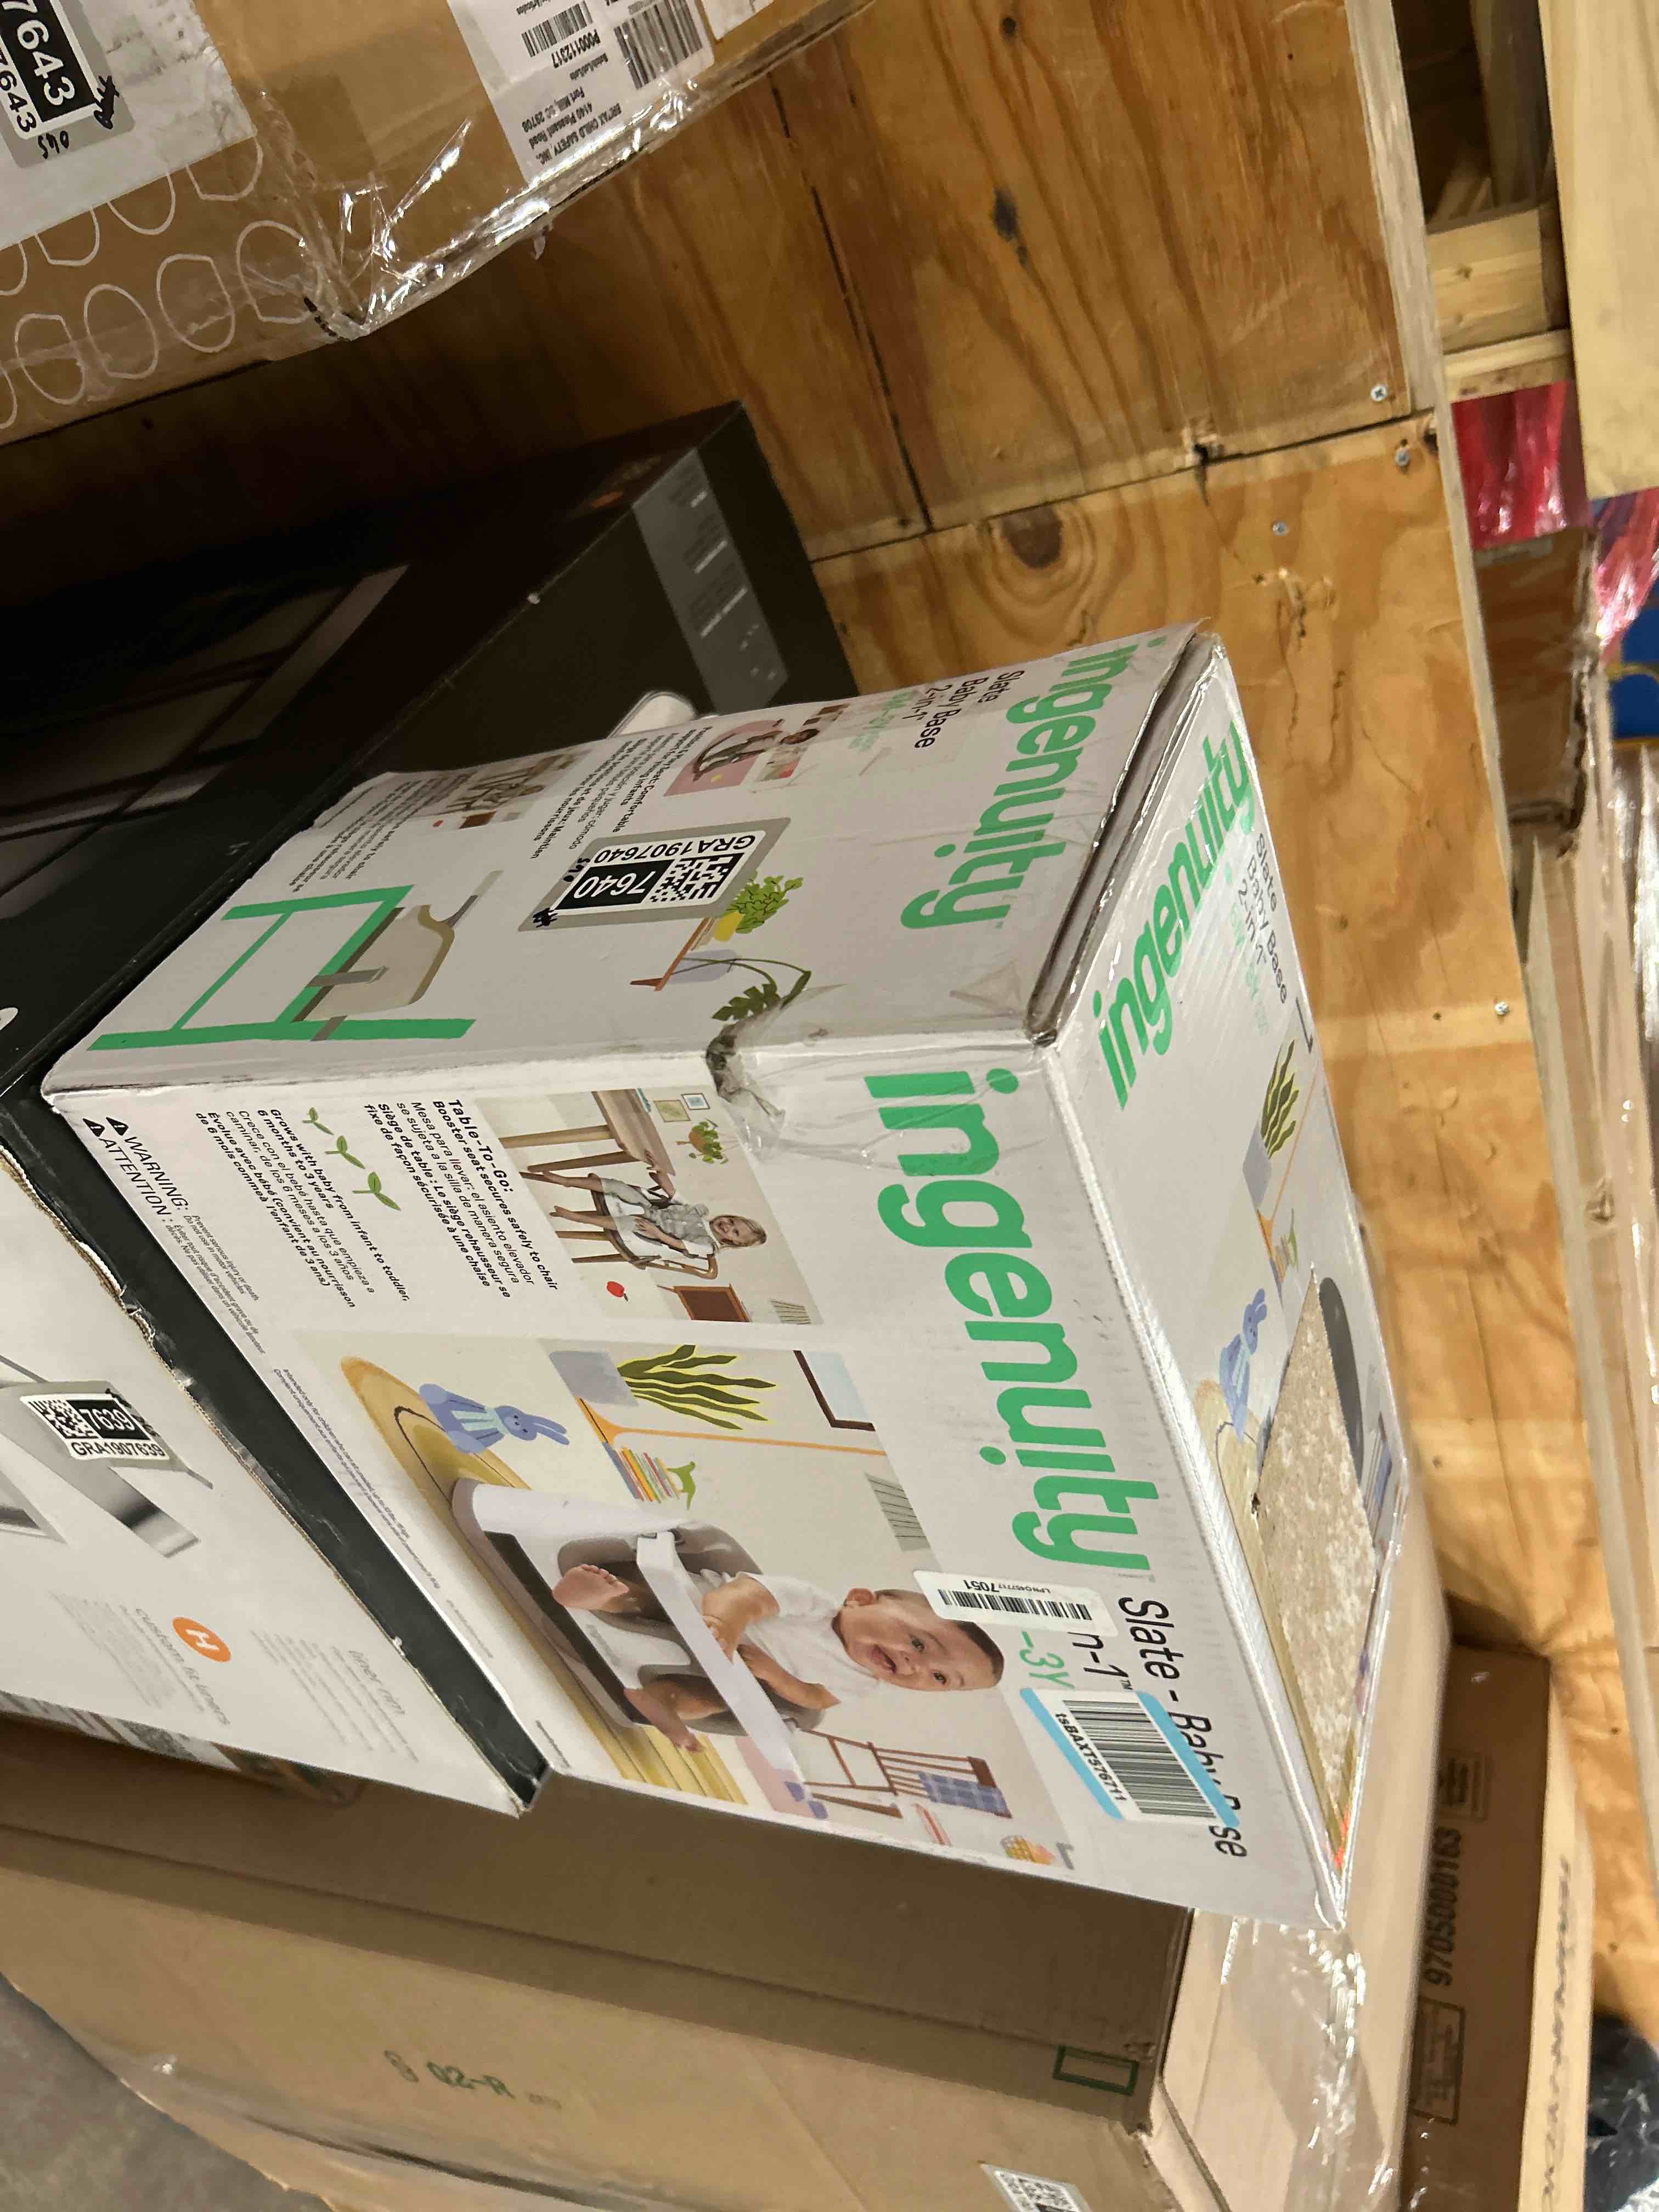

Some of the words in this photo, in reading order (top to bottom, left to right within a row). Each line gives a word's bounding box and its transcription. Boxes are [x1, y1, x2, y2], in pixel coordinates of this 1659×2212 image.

[2, 0, 75, 106] 7643
[937, 676, 990, 708] Baby
[978, 670, 1025, 703] Slate
[914, 708, 961, 749] Base
[533, 797, 580, 840] nourrissons
[557, 806, 579, 825] jeux:
[578, 785, 618, 822] pequeños
[612, 785, 654, 832] Comfortable
[620, 777, 653, 805] infants
[531, 825, 564, 859] Maintien
[568, 820, 596, 849] cómodo
[594, 834, 756, 864] GRA1907640
[1256, 832, 1277, 912] Slate
[573, 870, 656, 899] 7640
[1247, 854, 1269, 930] Baby
[1267, 929, 1287, 1004] Base
[99, 1138, 171, 1215] ATTENTION
[125, 1137, 188, 1209] WARNING:
[263, 1119, 296, 1157] months
[295, 1159, 306, 1170] to
[308, 1181, 334, 1208] years
[449, 1099, 512, 1191] Table-To-Go:
[195, 1113, 208, 1125] de
[213, 1136, 235, 1159] mois
[266, 1206, 298, 1243] l'enfant
[295, 1245, 307, 1256] de
[310, 1266, 330, 1286] ans)
[207, 1112, 236, 1144] Évolue
[235, 1147, 256, 1170] avec
[253, 1172, 277, 1195] bébé
[272, 1198, 310, 1243] (convient
[307, 1245, 319, 1256] au
[317, 1259, 355, 1307] nourrisson
[226, 1111, 261, 1153] caminar,
[259, 1155, 272, 1167] de
[269, 1170, 284, 1183] los
[288, 1194, 314, 1224] meses
[317, 1235, 331, 1248] los
[334, 1258, 353, 1280] años
[239, 1110, 264, 1139] Crece
[262, 1142, 279, 1159] con
[277, 1162, 290, 1170] el
[285, 1173, 307, 1196] bebé
[303, 1199, 327, 1226] hasta
[324, 1228, 341, 1245] que
[338, 1248, 369, 1285] empieza
[270, 1109, 298, 1141] Grows
[296, 1143, 317, 1166] with
[313, 1169, 335, 1192] baby
[332, 1194, 353, 1218] from
[351, 1221, 377, 1251] infant
[373, 1252, 384, 1263] to
[382, 1265, 409, 1301] toddler,
[364, 1104, 382, 1125] fixe
[380, 1127, 393, 1140] de
[391, 1142, 415, 1172] façon
[413, 1175, 449, 1224] sécurisée
[452, 1235, 469, 1252] une
[465, 1255, 490, 1286] chaise
[378, 1104, 403, 1132] Siège
[400, 1135, 413, 1148] de
[411, 1150, 433, 1177] table
[433, 1186, 445, 1197] Le
[443, 1200, 465, 1226] siège
[461, 1229, 502, 1284] rehausseur
[498, 1286, 510, 1297] se
[396, 1103, 410, 1115] se
[407, 1118, 434, 1150] sujeta
[436, 1162, 447, 1171] la
[444, 1173, 461, 1193] silla
[458, 1195, 471, 1207] de
[468, 1210, 496, 1248] manera
[493, 1250, 519, 1283] segura
[411, 1102, 435, 1130] Mesa
[429, 1133, 452, 1156] para
[449, 1159, 474, 1189] llevar:
[471, 1192, 484, 1201] el
[478, 1204, 506, 1240] asiento
[503, 1243, 534, 1284] elevador
[433, 1101, 467, 1144] Booster
[463, 1147, 485, 1171] seat
[480, 1173, 511, 1215] secures
[507, 1217, 533, 1249] safely
[529, 1251, 540, 1262] to
[537, 1264, 557, 1289] chair
[866, 1069, 1158, 1569] ingenuity
[71, 1441, 165, 1457] GRA1907639
[78, 1408, 136, 1431] 7639
[135, 1606, 185, 1664] custom
[1117, 1596, 1184, 1681] Slate
[1167, 1690, 1180, 1704] -
[1168, 1711, 1223, 1785] Bab
